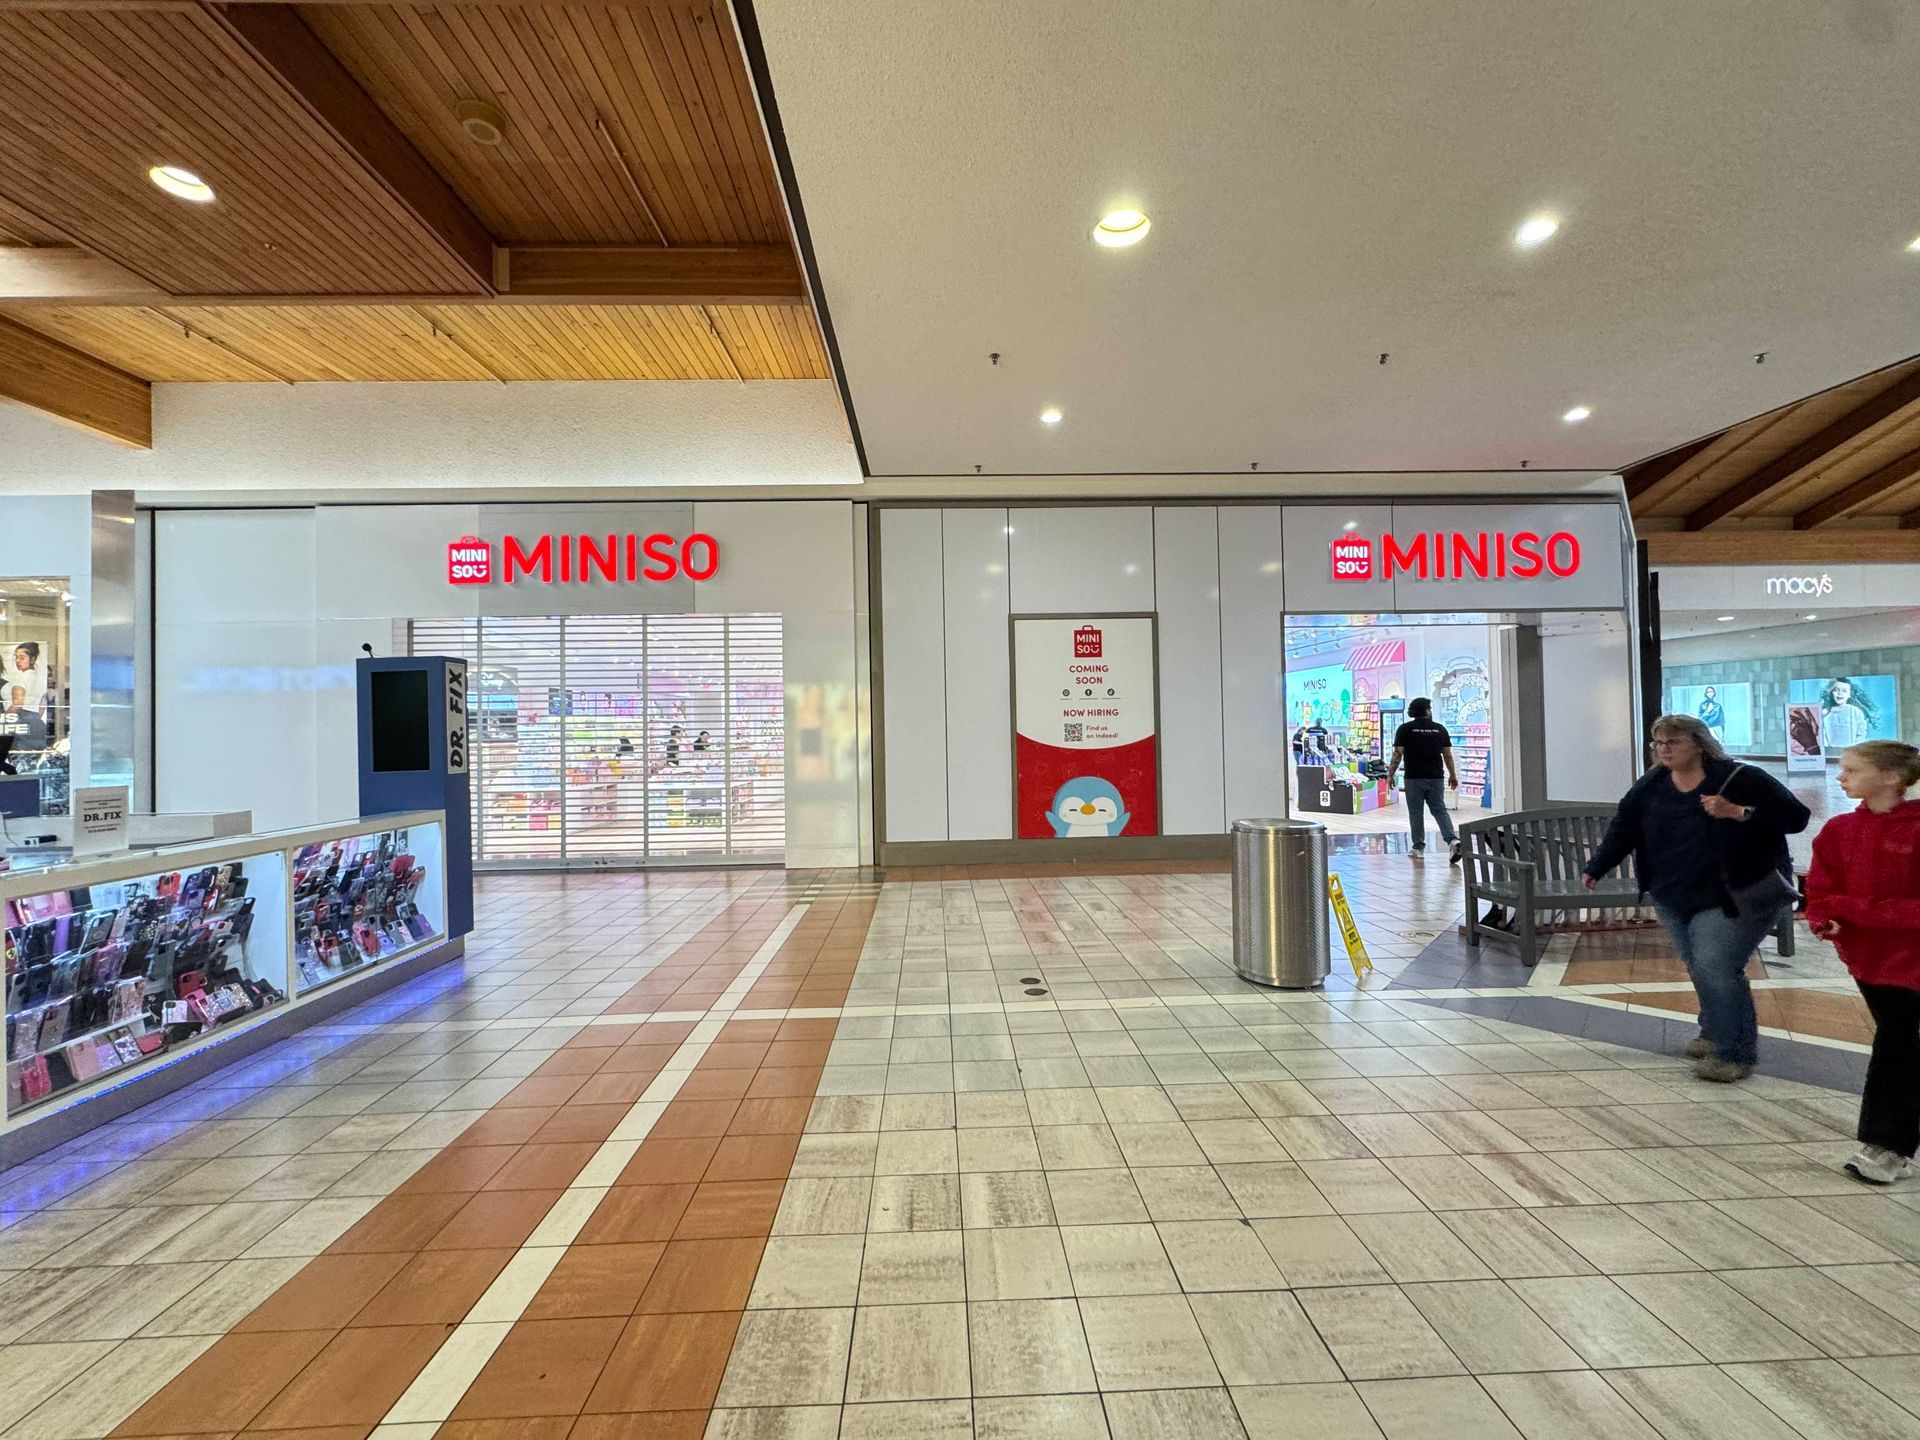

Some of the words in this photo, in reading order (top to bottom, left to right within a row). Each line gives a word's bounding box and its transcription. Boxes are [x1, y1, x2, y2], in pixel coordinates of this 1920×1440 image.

[451, 549, 487, 562] MINI
[503, 533, 719, 583] MINISO
[1336, 545, 1368, 559] MINI
[1382, 531, 1581, 580] MINISO
[1076, 633, 1100, 643] MINI
[1069, 665, 1110, 673] COMING
[1075, 676, 1103, 685] SOON
[449, 668, 463, 715] FIX
[1063, 709, 1085, 717] NOW
[1087, 708, 1119, 717] HIRING
[450, 726, 464, 768] DR.
